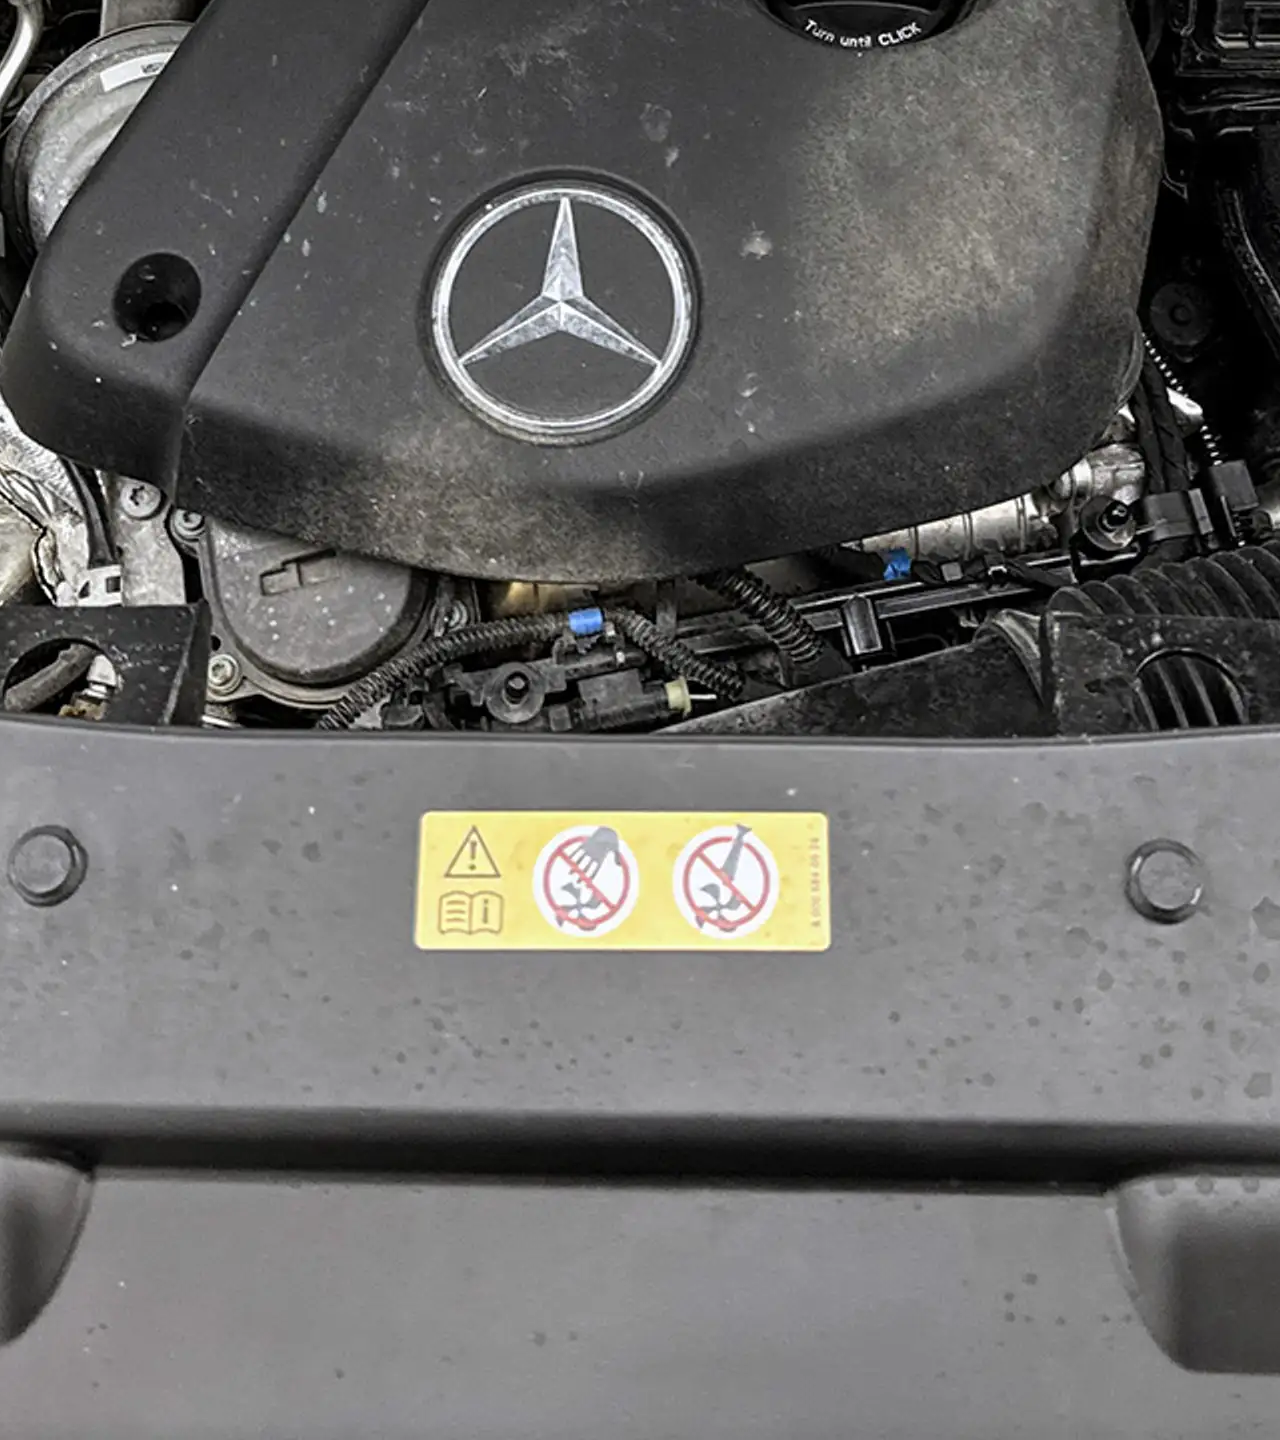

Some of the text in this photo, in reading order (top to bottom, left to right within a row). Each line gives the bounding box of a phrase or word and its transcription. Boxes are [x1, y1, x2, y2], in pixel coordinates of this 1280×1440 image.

[804, 19, 922, 48] Turn until CLICK
